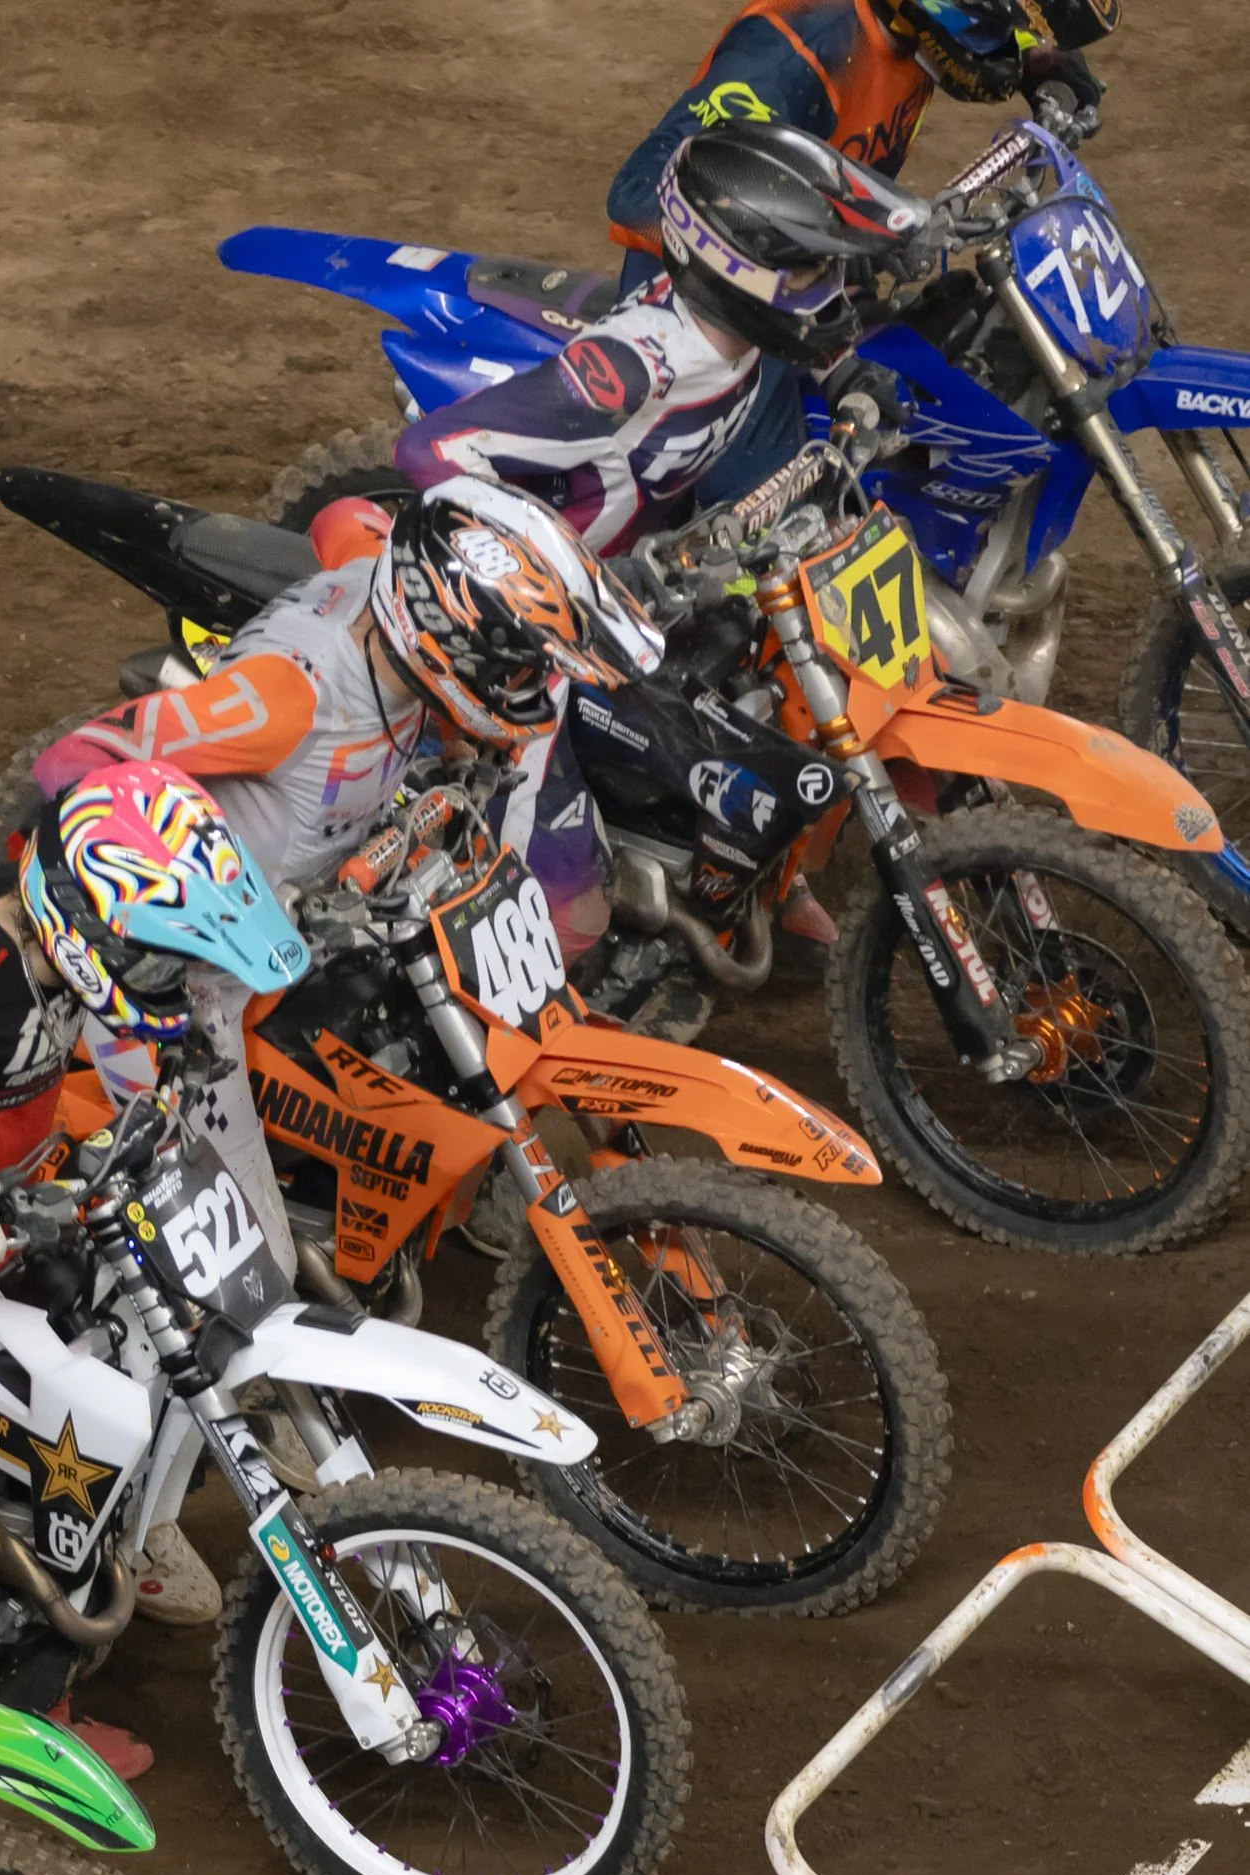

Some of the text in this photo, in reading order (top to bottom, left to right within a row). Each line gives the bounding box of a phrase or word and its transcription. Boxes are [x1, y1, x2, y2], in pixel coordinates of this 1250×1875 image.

[957, 134, 1032, 195] RENTHAL
[1024, 209, 1146, 334] 724
[456, 530, 521, 580] 488
[393, 599, 415, 644] BELL
[848, 544, 922, 671] 47
[367, 799, 447, 868] RENHAL
[471, 877, 566, 1029] 488
[325, 1045, 405, 1096] RTF
[577, 1067, 680, 1099] MOTOPRO
[249, 1069, 436, 1187] ANDANELLA
[350, 1162, 410, 1202] SEPTIC
[160, 1170, 265, 1298] 522
[416, 1401, 484, 1425] ROCKSTAR
[282, 1560, 350, 1655] MOTOREX
